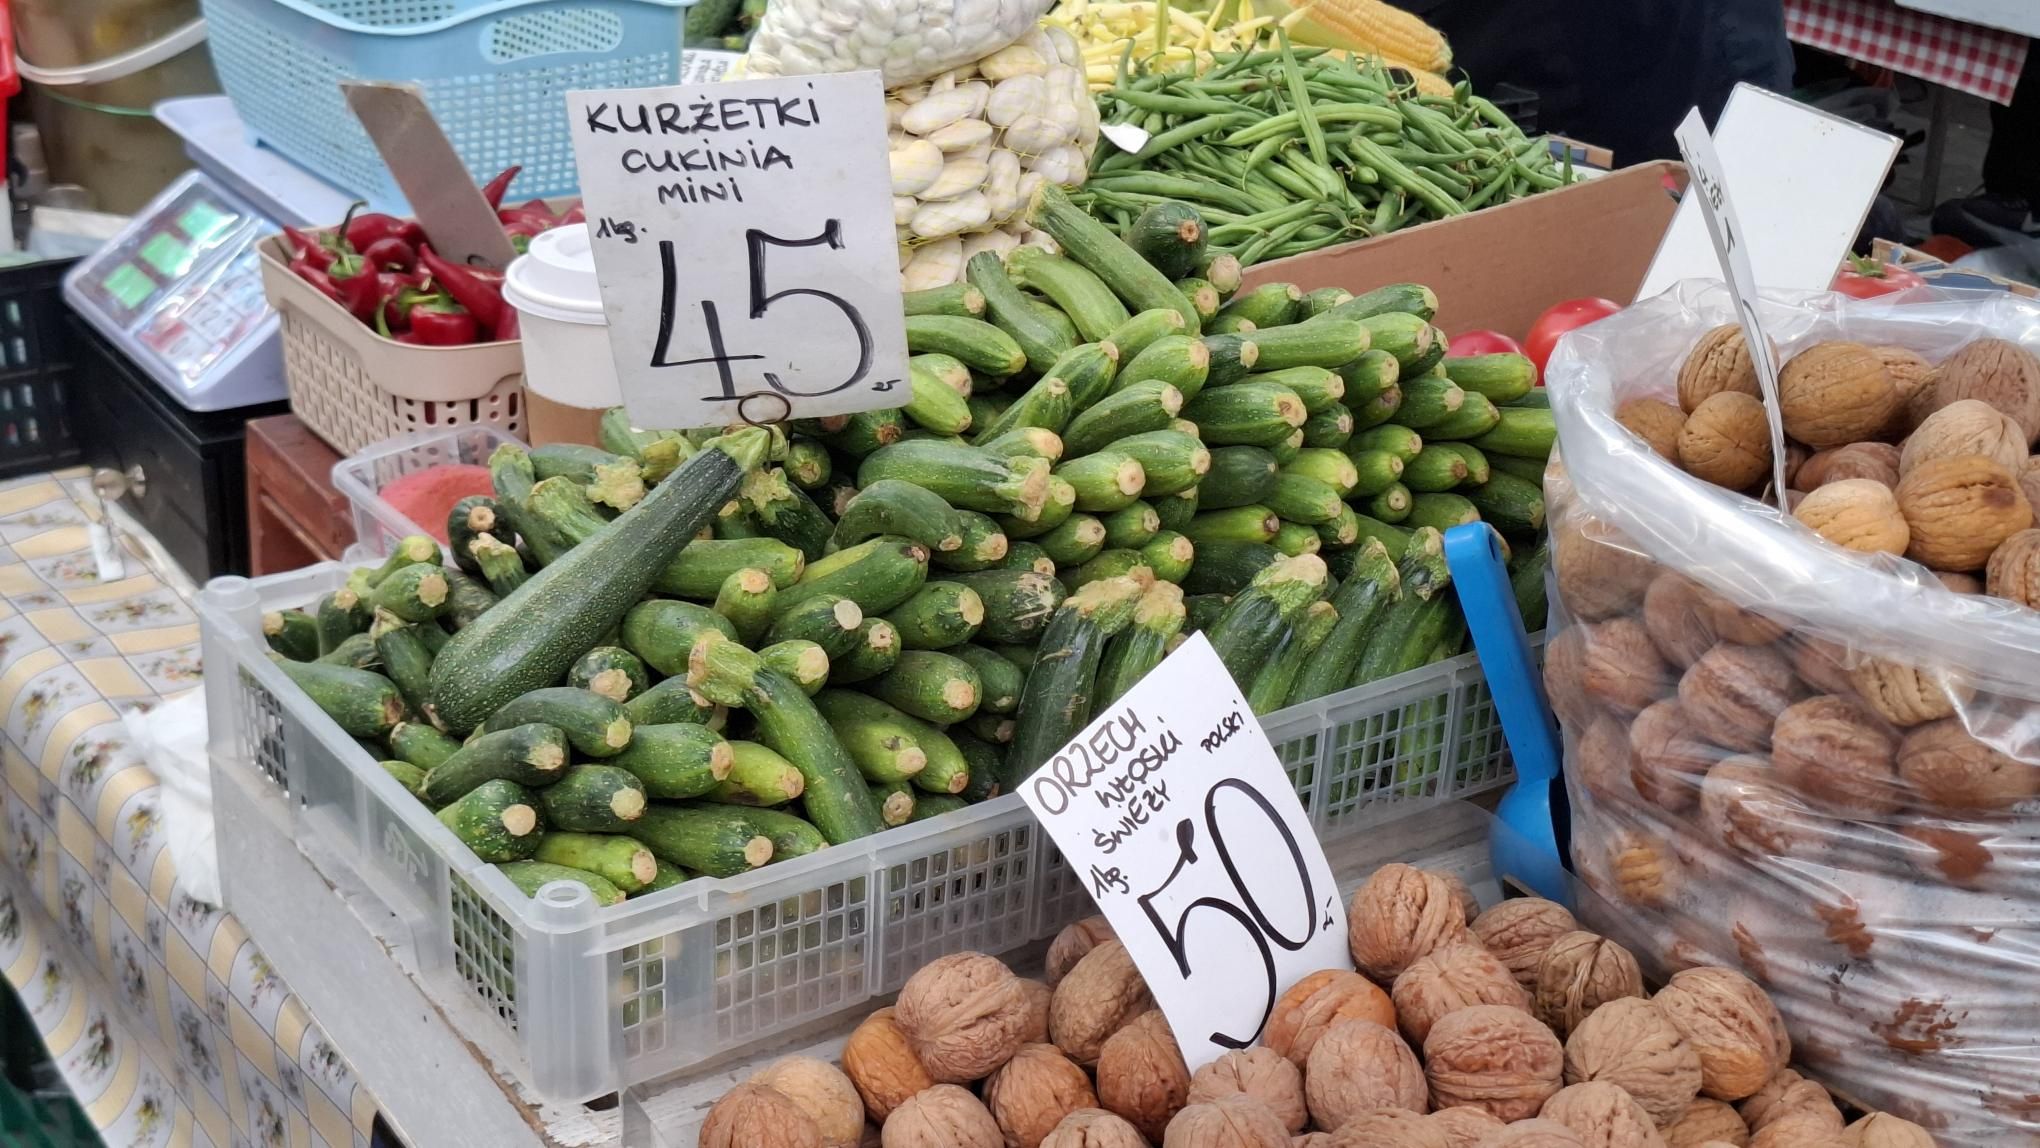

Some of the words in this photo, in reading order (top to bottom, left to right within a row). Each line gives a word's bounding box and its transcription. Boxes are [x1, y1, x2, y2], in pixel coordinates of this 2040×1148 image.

[586, 82, 820, 134] KURŻETKI
[621, 139, 794, 173] CUKINIA
[658, 177, 744, 205] MINI
[650, 219, 875, 402] 45
[1200, 700, 1245, 754] POLSKI
[1034, 707, 1147, 816] ORZECH
[1137, 777, 1317, 1049] 50
